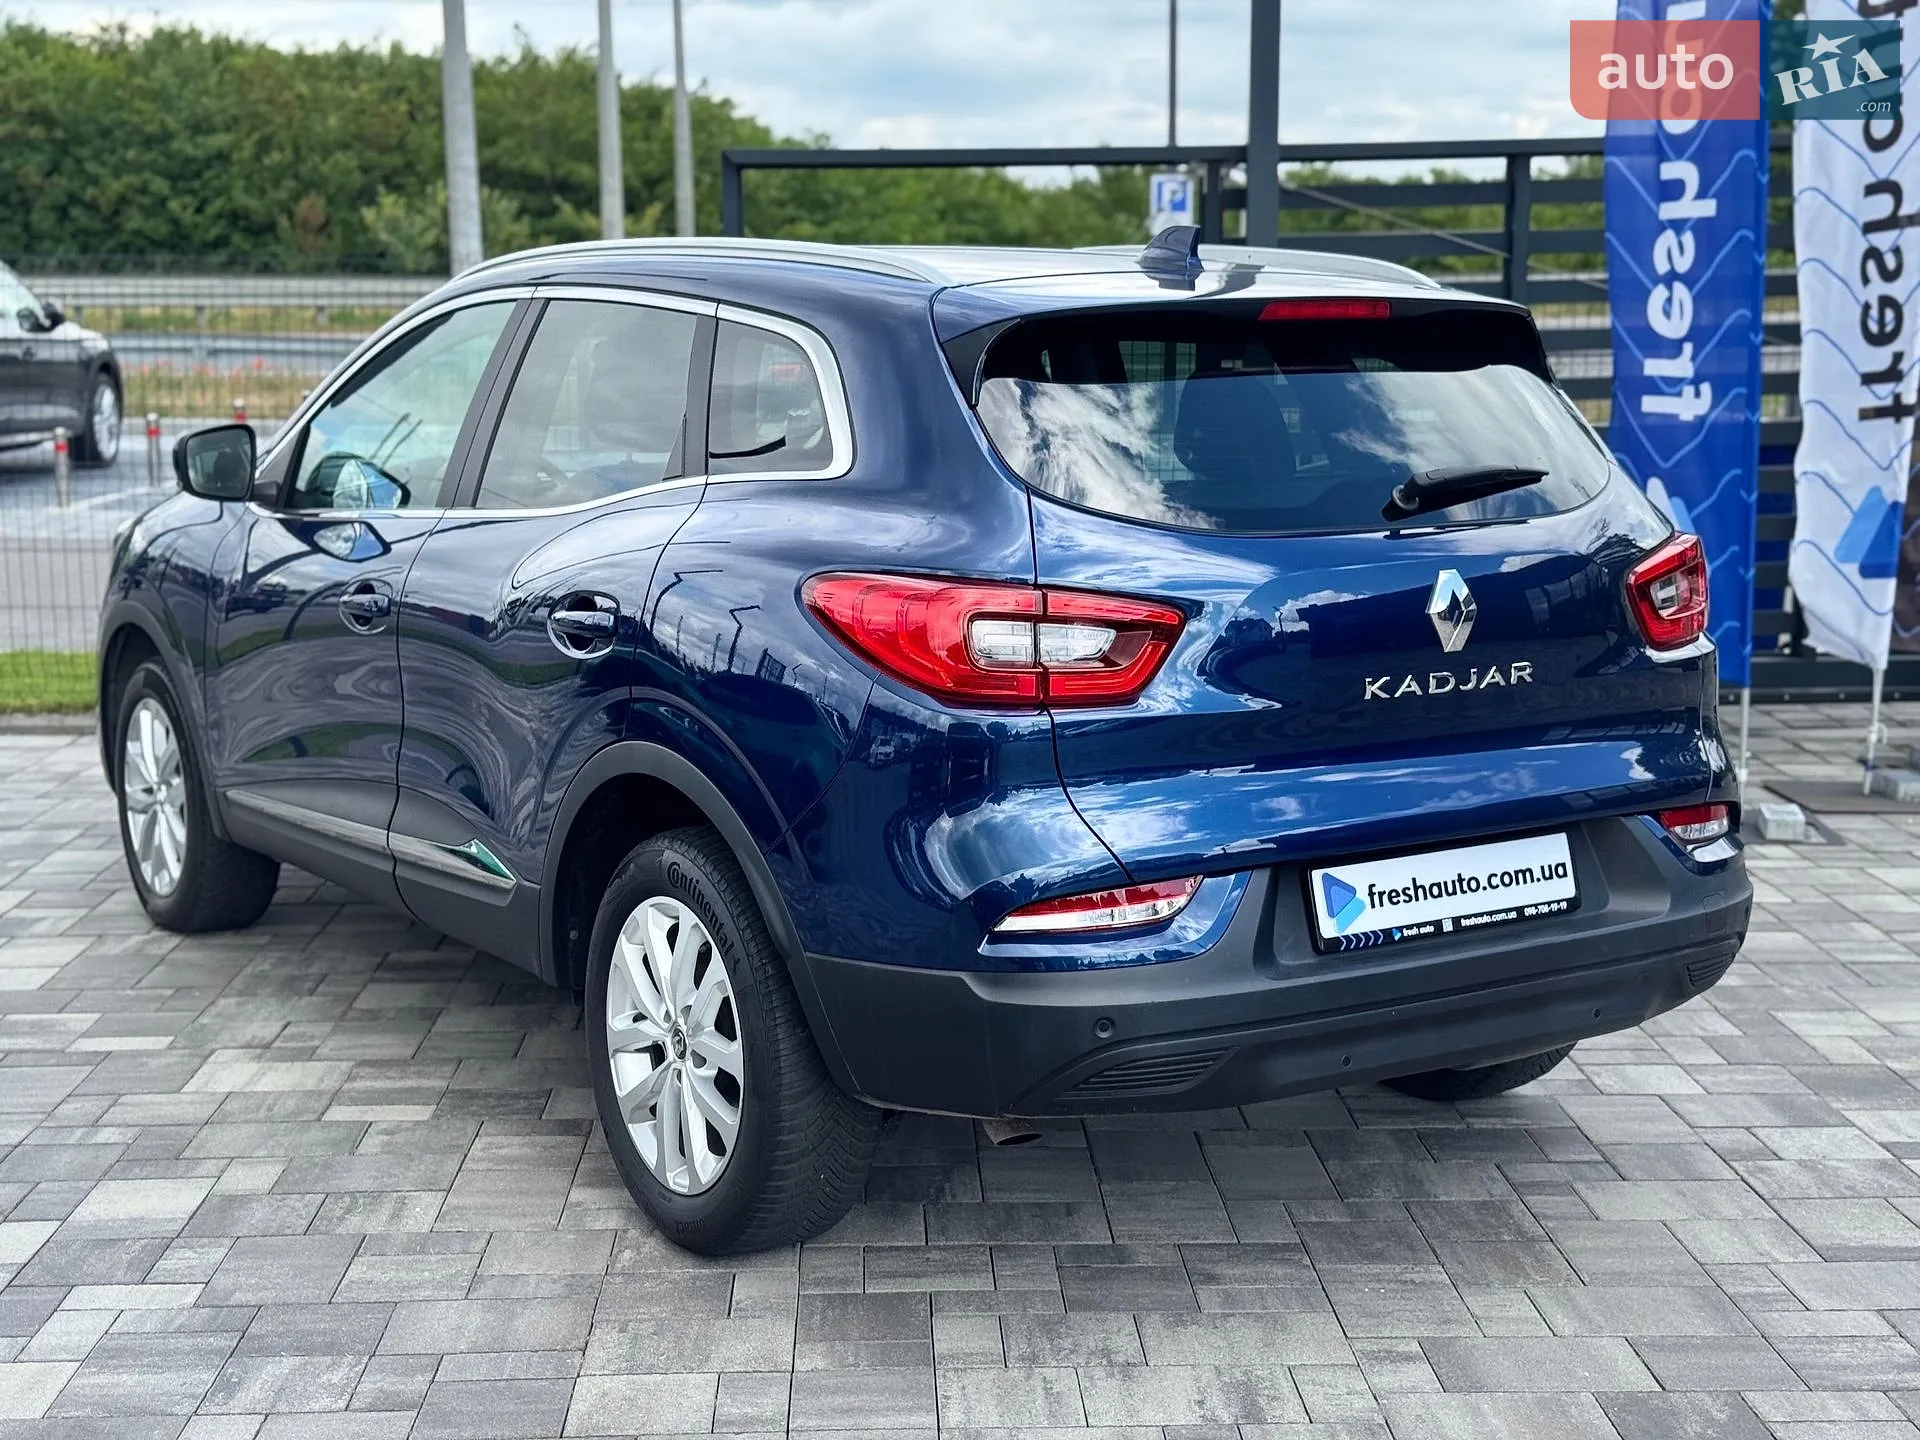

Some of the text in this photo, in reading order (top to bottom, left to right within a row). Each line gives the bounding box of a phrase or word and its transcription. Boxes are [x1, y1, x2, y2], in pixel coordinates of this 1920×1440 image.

[1363, 661, 1534, 701] KADJAR
[1367, 861, 1569, 910] freshauto.com.ua
[667, 861, 736, 957] Continental
[1402, 926, 1418, 937] fresh
[1420, 925, 1434, 934] auto
[1461, 911, 1517, 927] freshauto.com.ua
